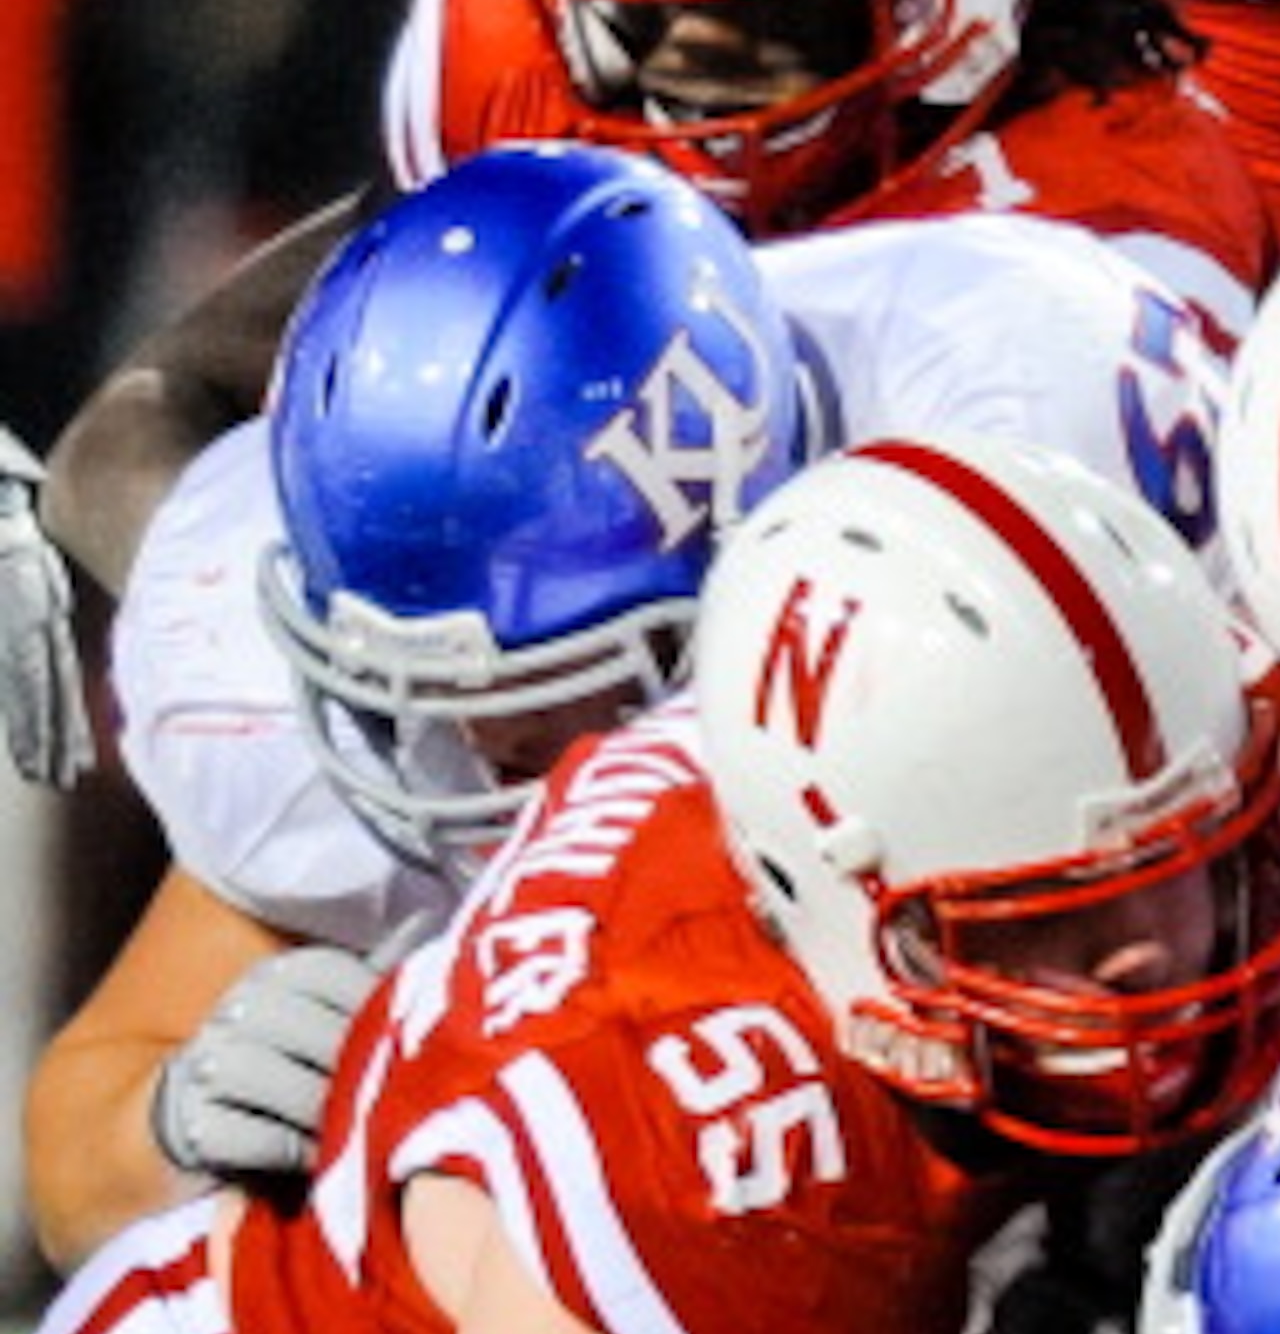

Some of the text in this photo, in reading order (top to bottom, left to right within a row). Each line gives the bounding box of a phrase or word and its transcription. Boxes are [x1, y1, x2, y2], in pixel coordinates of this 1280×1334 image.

[583, 291, 770, 552] KU
[753, 577, 862, 752] N
[646, 1004, 847, 1217] 55
